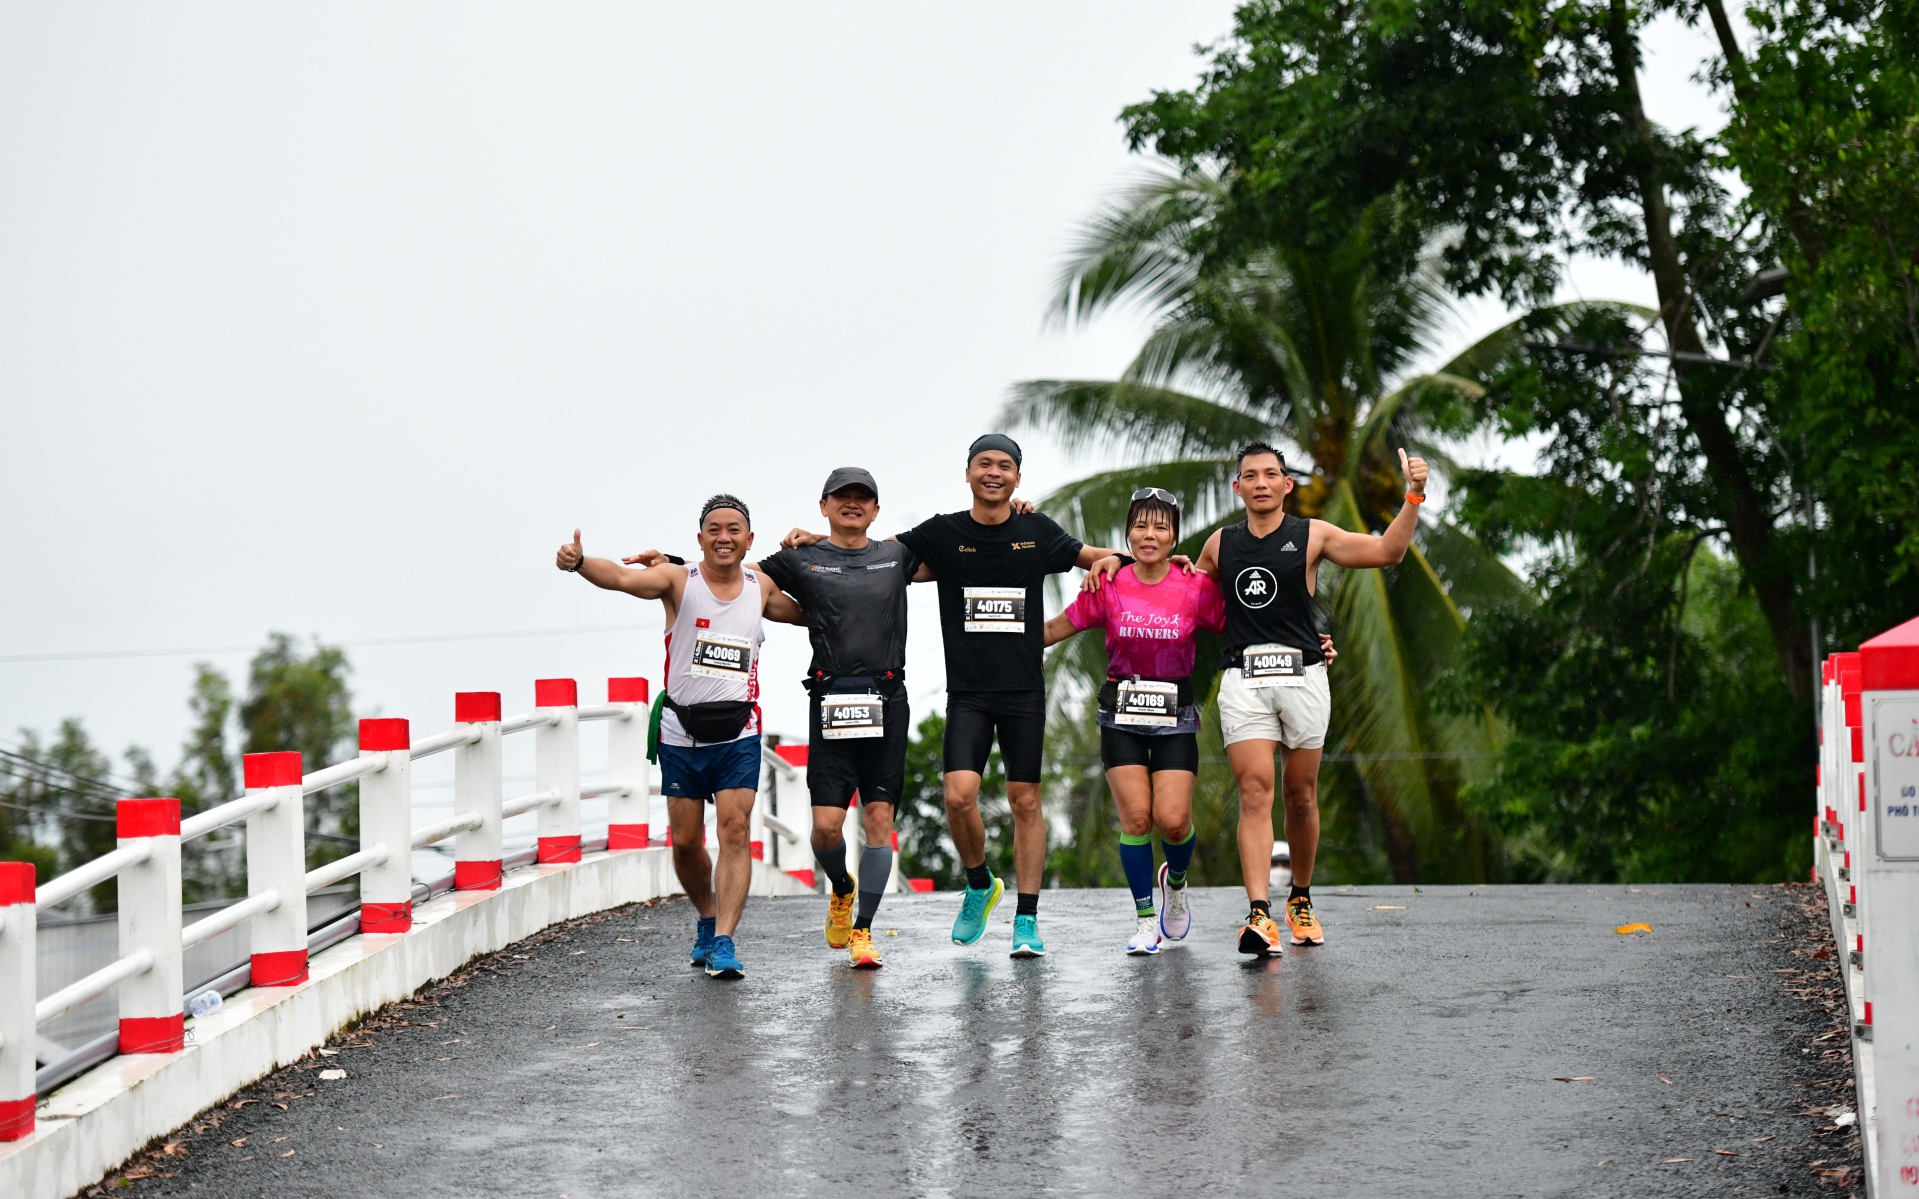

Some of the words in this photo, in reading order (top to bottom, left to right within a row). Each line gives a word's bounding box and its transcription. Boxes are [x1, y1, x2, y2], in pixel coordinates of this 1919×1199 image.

[977, 599, 1013, 613] 40175
[1120, 610, 1146, 623] The
[1143, 613, 1171, 628] Joy
[1119, 626, 1179, 640] RUNNERS
[705, 644, 741, 662] 40069
[1253, 654, 1292, 669] 40049
[1128, 692, 1165, 707] 40169
[833, 706, 870, 720] 40153
[1887, 803, 1909, 818] PHÓ
